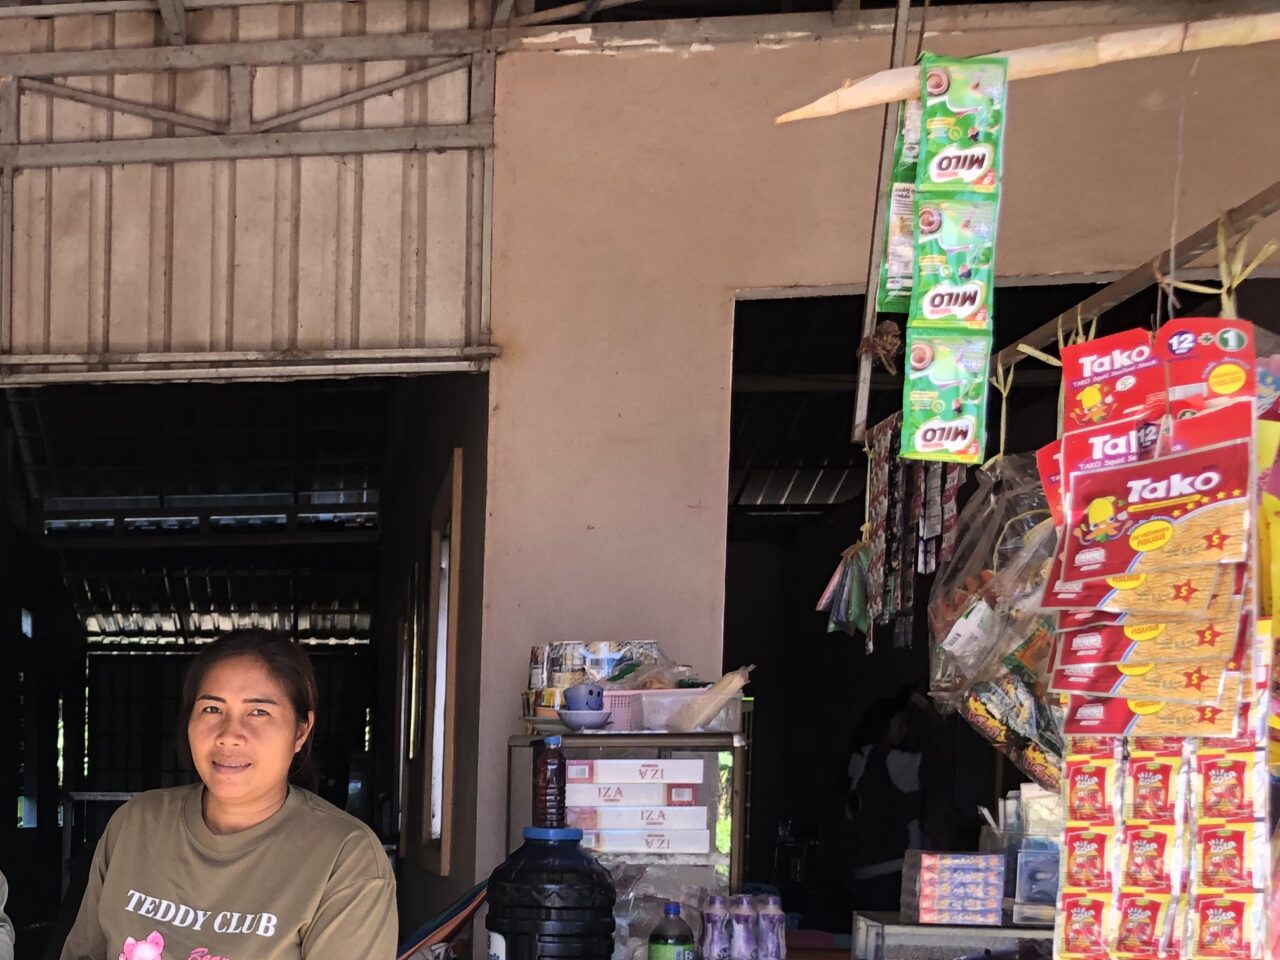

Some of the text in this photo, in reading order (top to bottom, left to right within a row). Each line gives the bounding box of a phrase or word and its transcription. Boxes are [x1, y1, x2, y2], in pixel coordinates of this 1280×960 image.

[937, 153, 987, 172] MILO
[929, 289, 979, 308] MILO
[1169, 334, 1195, 350] 12
[1078, 345, 1151, 377] Tako
[921, 425, 970, 443] MILO
[1127, 471, 1220, 504] Tako
[1203, 630, 1212, 641] 5
[1203, 708, 1212, 719] 5
[638, 768, 664, 780] IZA
[597, 786, 624, 798] IZA
[640, 810, 666, 821] IZA
[644, 838, 671, 850] IZA
[125, 889, 278, 938] TEDDY CLUB
